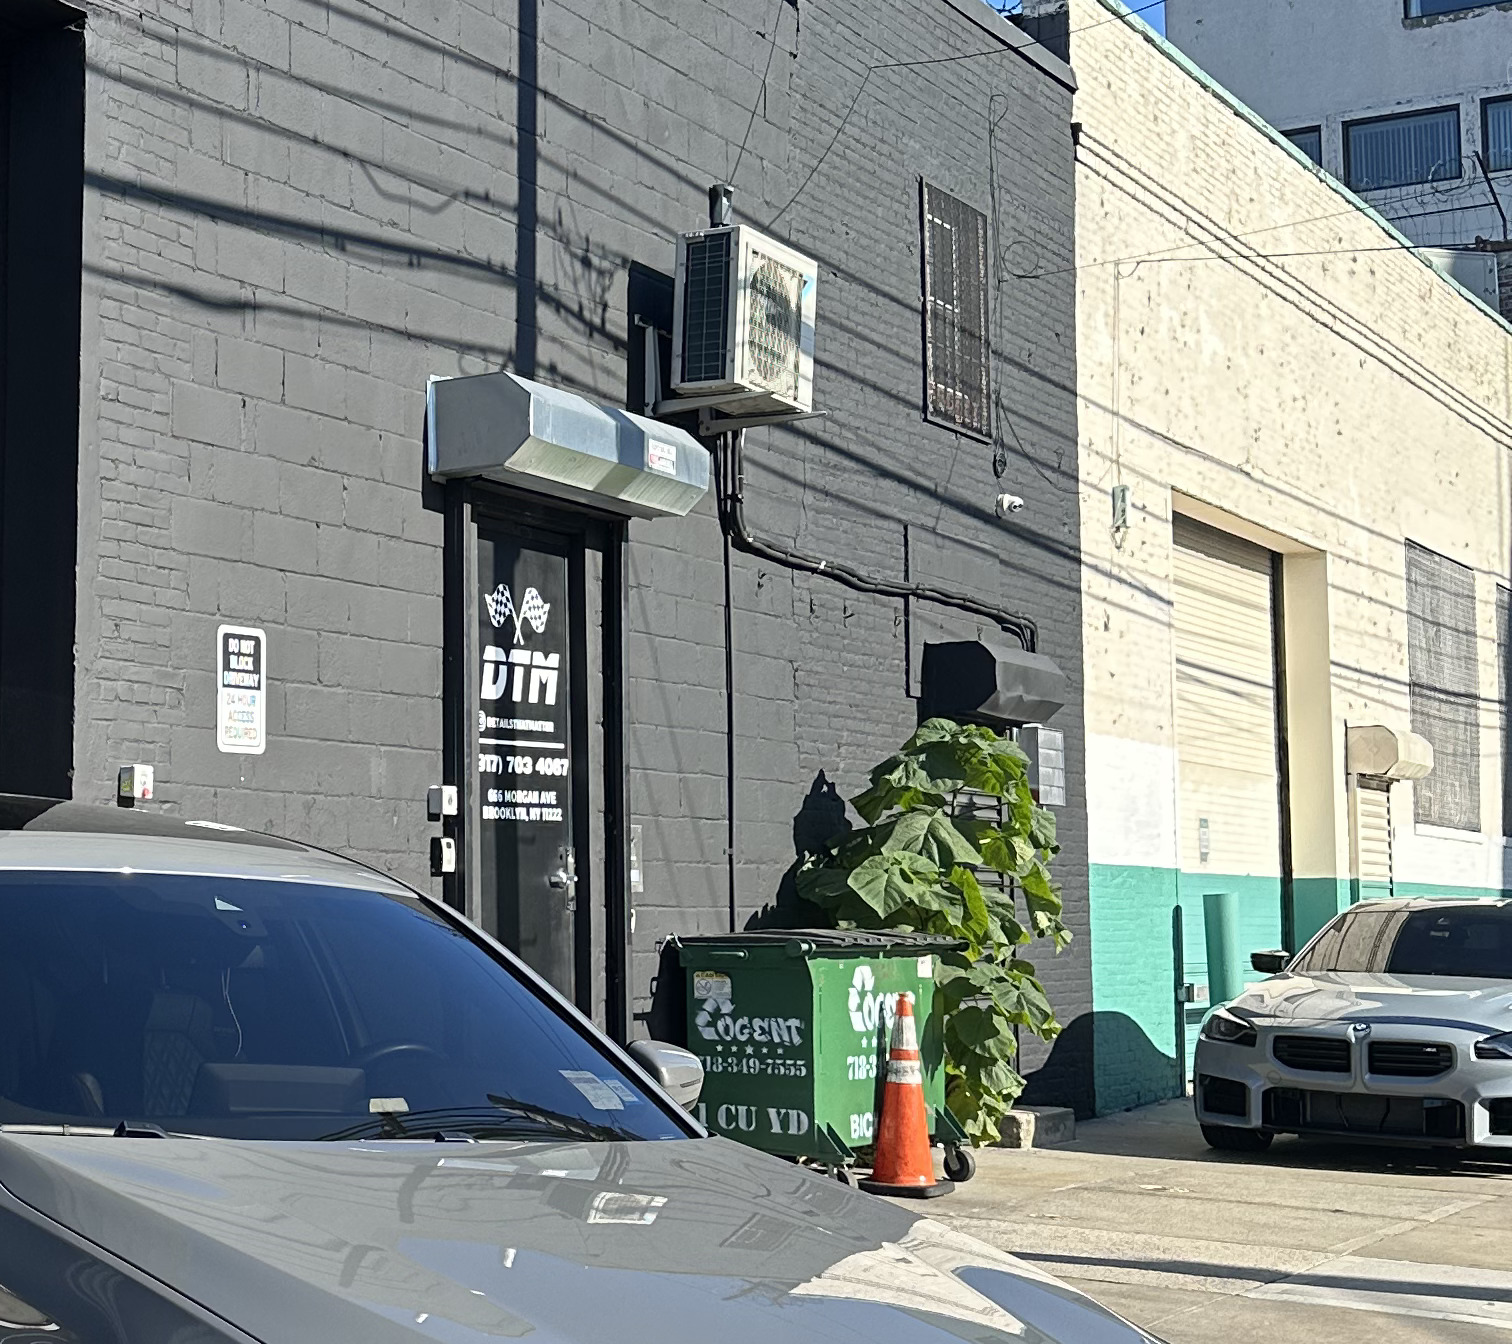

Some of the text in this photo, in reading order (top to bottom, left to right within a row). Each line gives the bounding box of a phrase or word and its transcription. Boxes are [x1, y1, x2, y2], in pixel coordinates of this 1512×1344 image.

[228, 638, 256, 655] DO NOT
[229, 654, 254, 671] BLOCK
[480, 645, 560, 706] DTM
[506, 755, 533, 775] 703
[504, 789, 540, 805] MORGAN
[540, 791, 557, 805] AVE
[529, 807, 541, 821] NY
[699, 1055, 807, 1077] 18-349-7555
[717, 1103, 758, 1132] CU
[766, 1107, 809, 1136] YD
